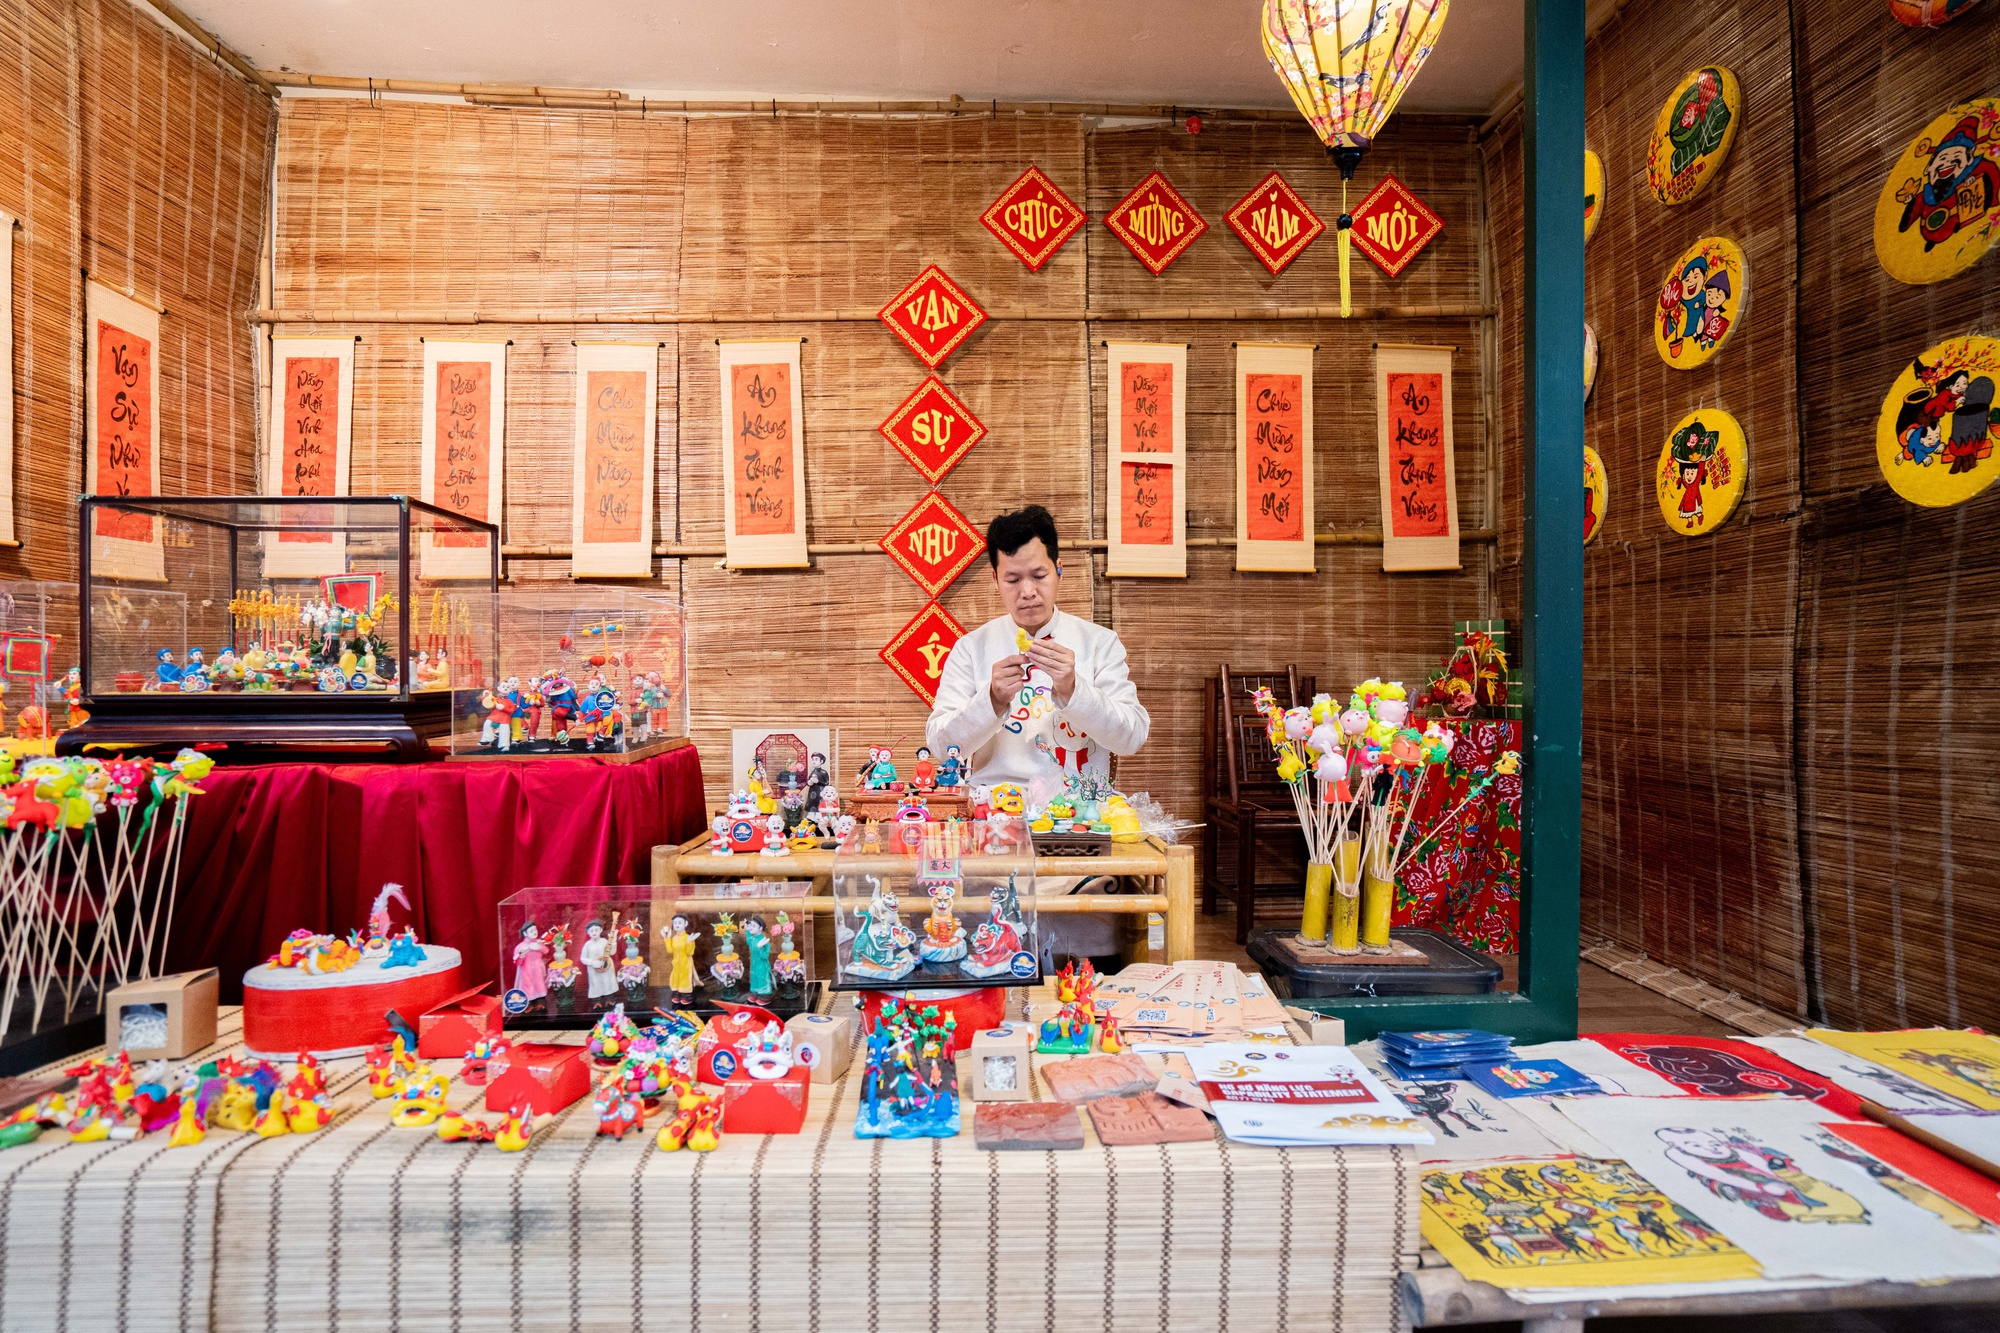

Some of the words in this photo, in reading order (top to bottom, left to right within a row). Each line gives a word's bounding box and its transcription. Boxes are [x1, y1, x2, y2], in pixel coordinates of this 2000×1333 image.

[1005, 191, 1063, 242] CHÚC
[1129, 192, 1185, 246] MỪNG
[1251, 190, 1300, 249] NĂM
[1366, 200, 1418, 252] MỚI
[905, 289, 960, 344] VẠN
[112, 344, 138, 387] Vạn
[297, 370, 324, 391] Năm
[598, 387, 634, 411] Chúc
[747, 374, 776, 408] An
[1133, 375, 1158, 396] Năm
[1257, 388, 1291, 414] Chúc
[1402, 383, 1430, 415] An
[111, 391, 140, 430] Sự
[298, 393, 322, 414] Mới
[1136, 397, 1158, 416] Mới
[741, 411, 786, 446] Khang
[912, 409, 955, 453] SỰ
[1254, 421, 1293, 453] Mừng
[1396, 418, 1438, 450] Khang
[294, 438, 322, 458] Hoa
[295, 463, 320, 483] Phú
[597, 456, 632, 488] Năm
[744, 448, 784, 483] Thịnh
[1258, 456, 1292, 488] Năm
[1399, 453, 1437, 488] Thịnh
[450, 489, 469, 509] An
[598, 493, 629, 524] Mới
[746, 487, 783, 519] Vượng
[1259, 492, 1290, 523] Mới
[1402, 491, 1437, 522] Vượng
[909, 523, 959, 565] NHƯ
[917, 631, 951, 679] Ý
[1222, 1089, 1291, 1098] CAPABILITY
[1293, 1088, 1365, 1098] STATEMENT
